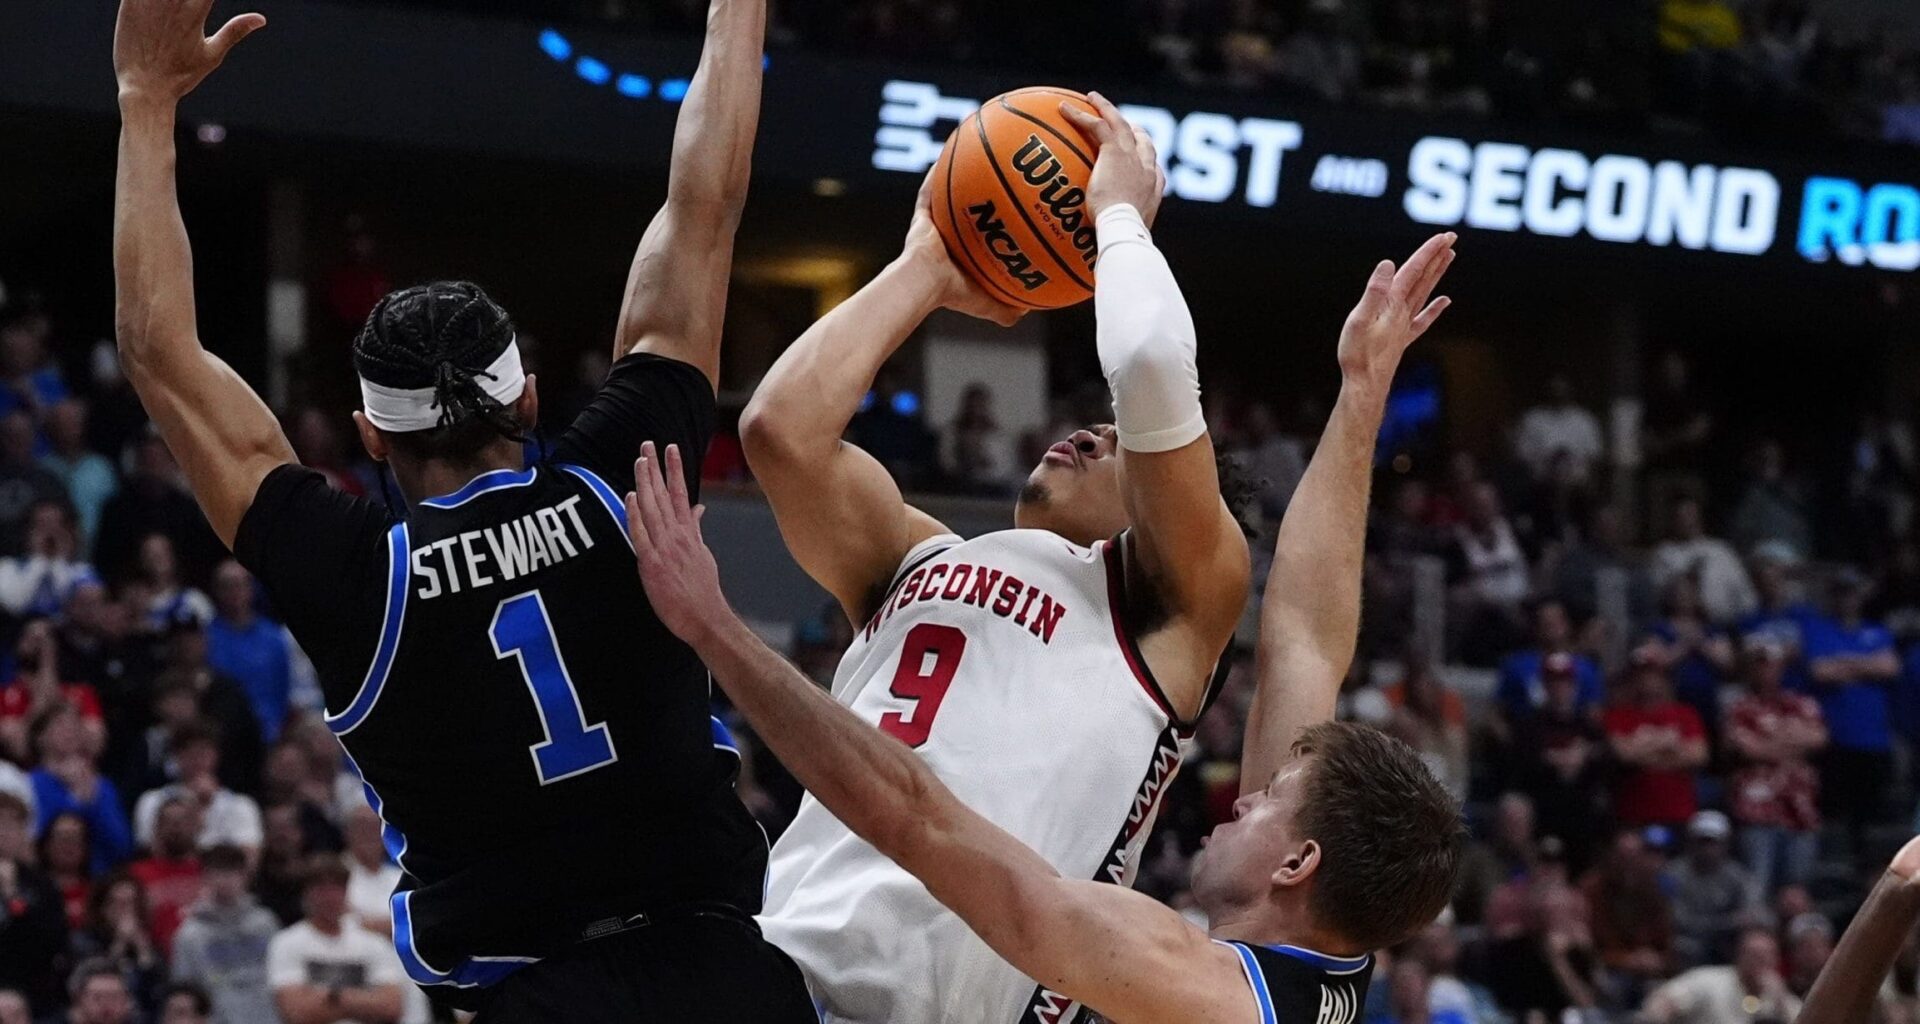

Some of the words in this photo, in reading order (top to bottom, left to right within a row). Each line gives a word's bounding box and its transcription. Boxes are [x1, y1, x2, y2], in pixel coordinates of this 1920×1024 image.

[1119, 103, 1304, 208] RST
[1403, 135, 1781, 256] SECOND
[968, 200, 1050, 291] NCAA
[411, 494, 595, 600] STEWART
[487, 588, 619, 786] 1
[877, 622, 968, 750] 9
